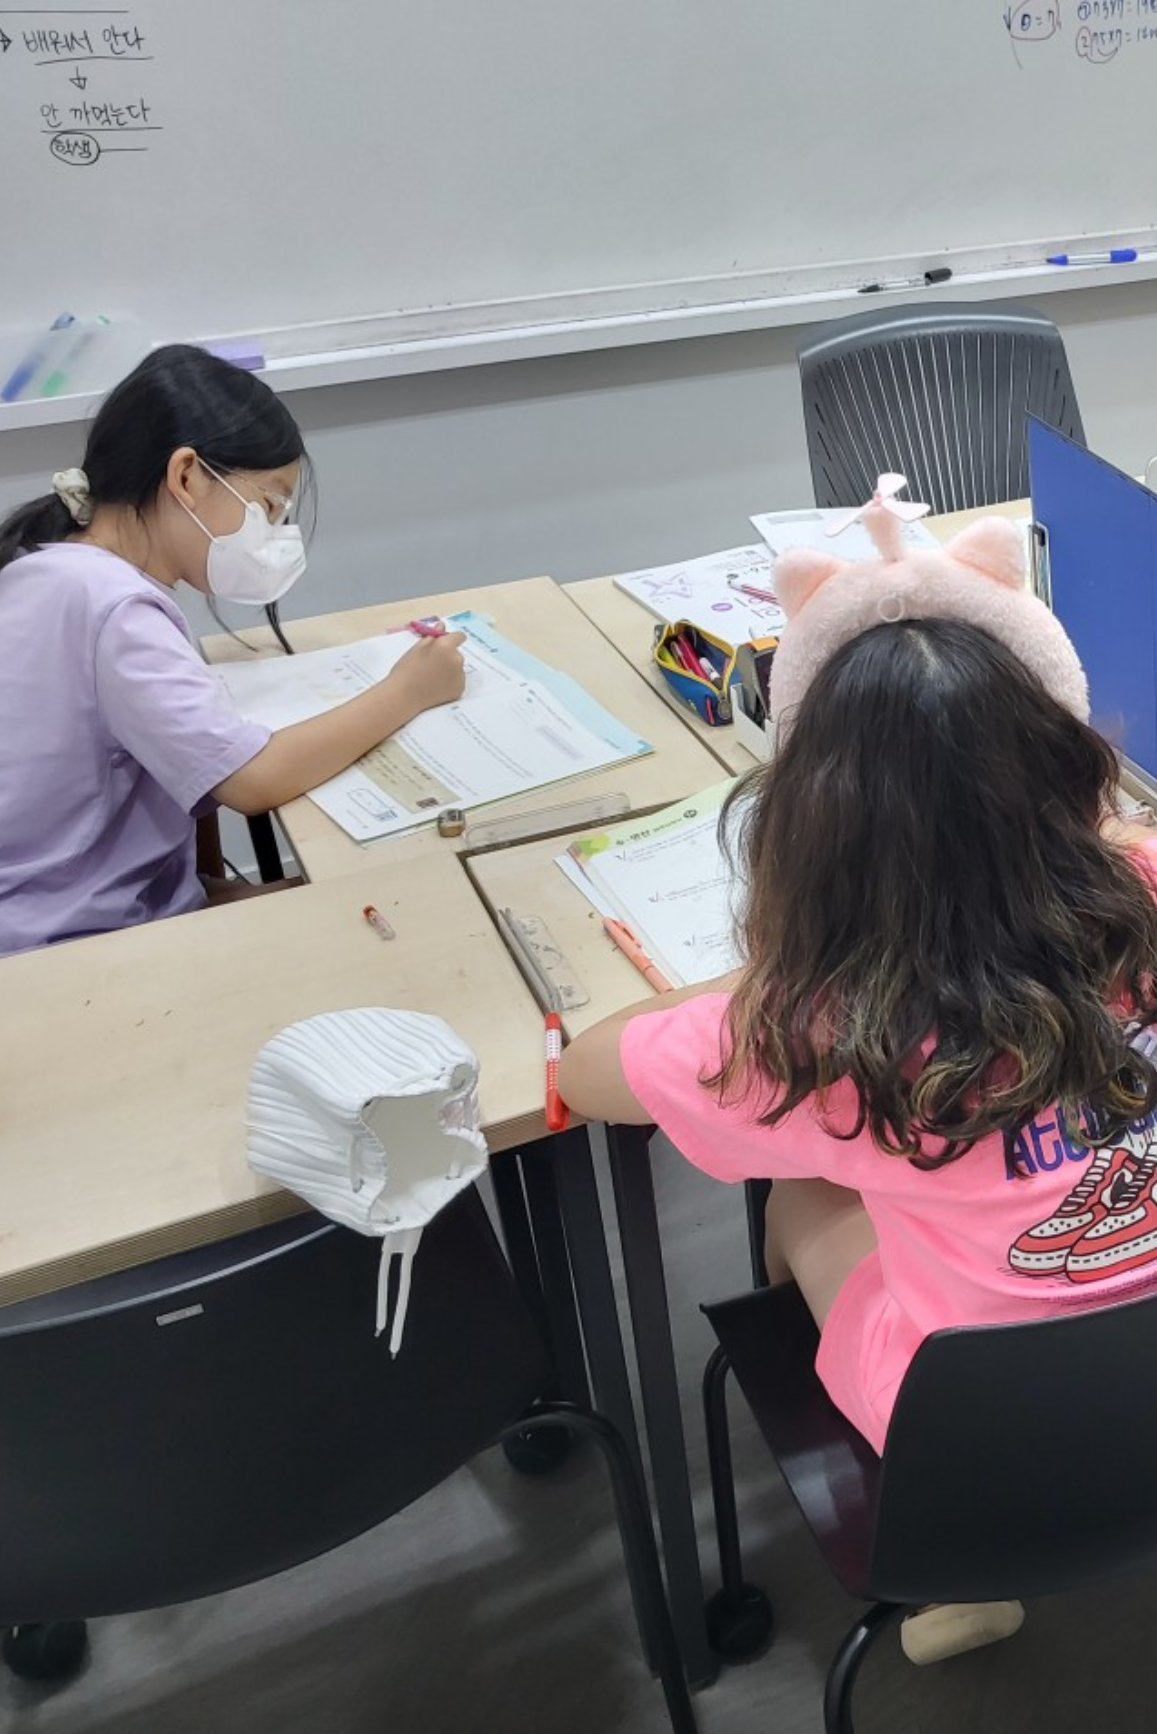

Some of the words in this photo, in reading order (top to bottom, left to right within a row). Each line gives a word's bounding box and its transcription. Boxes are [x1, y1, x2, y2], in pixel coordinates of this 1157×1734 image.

[22, 30, 93, 54] 배워서
[103, 25, 145, 55] 안다
[40, 103, 62, 128] 안
[71, 98, 151, 126] 까먹는다
